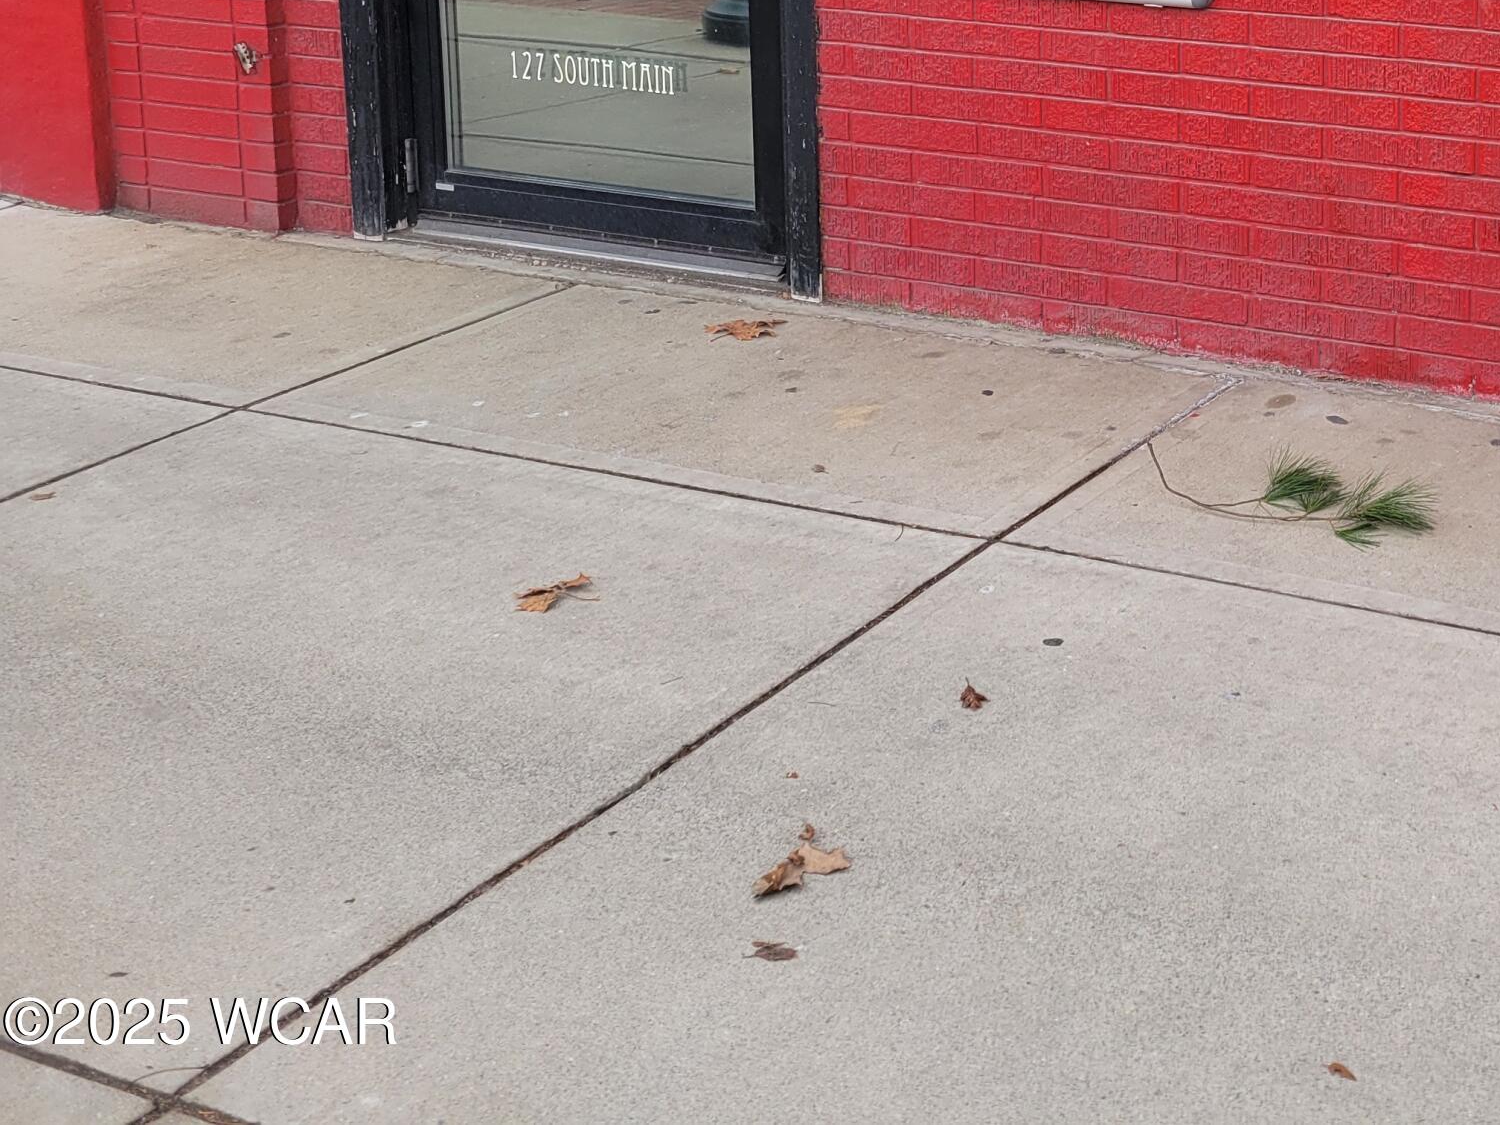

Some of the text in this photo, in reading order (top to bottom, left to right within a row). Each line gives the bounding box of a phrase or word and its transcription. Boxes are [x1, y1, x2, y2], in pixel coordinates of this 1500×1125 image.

[510, 51, 675, 95] 127 SOUTH MAIN
